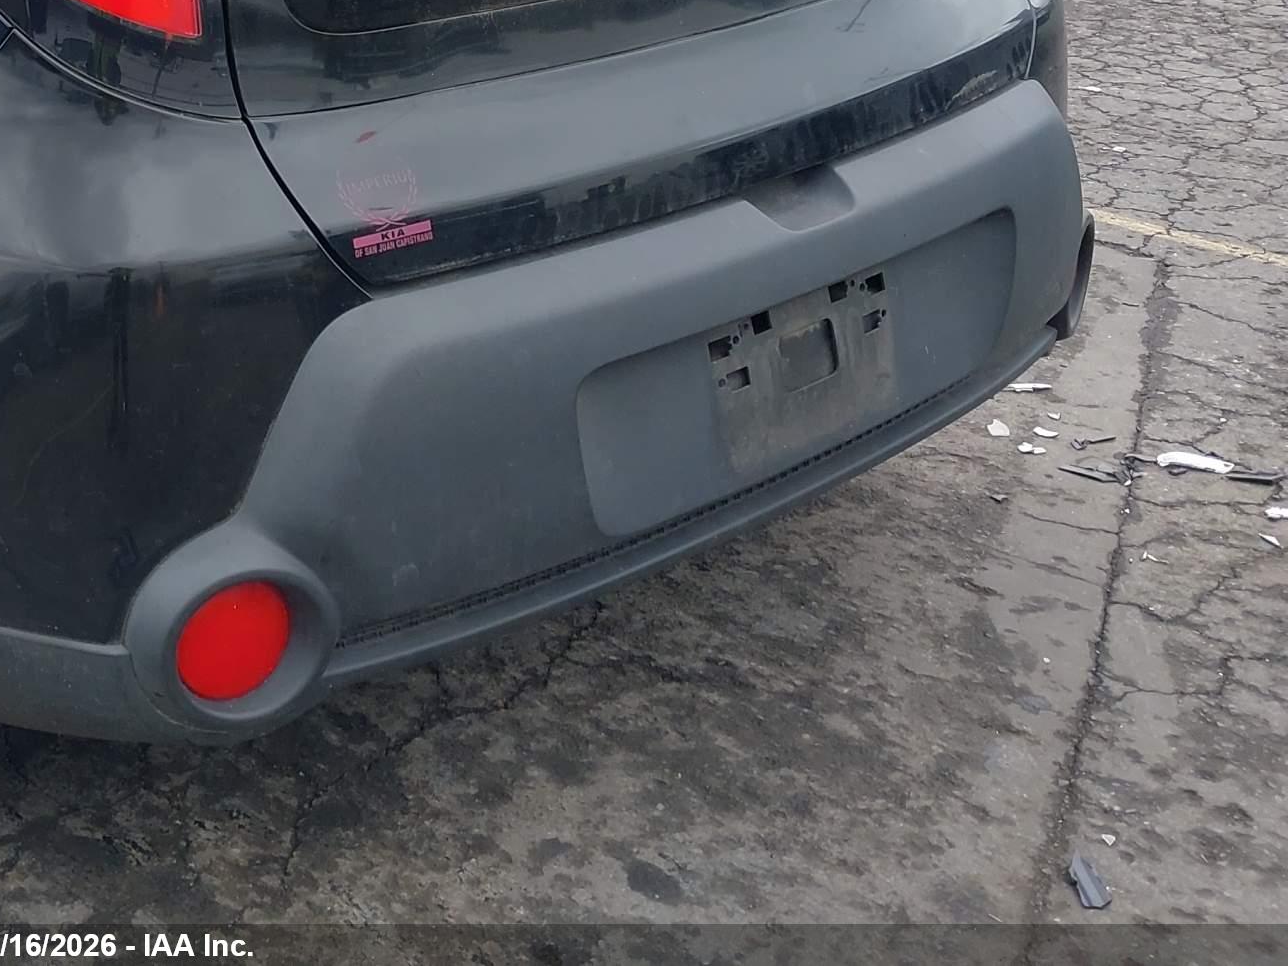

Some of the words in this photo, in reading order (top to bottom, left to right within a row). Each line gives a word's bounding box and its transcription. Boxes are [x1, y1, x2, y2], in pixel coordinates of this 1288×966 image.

[381, 229, 405, 241] KIA
[355, 249, 364, 258] OF
[364, 245, 377, 256] SAN
[378, 241, 396, 253] JUAN
